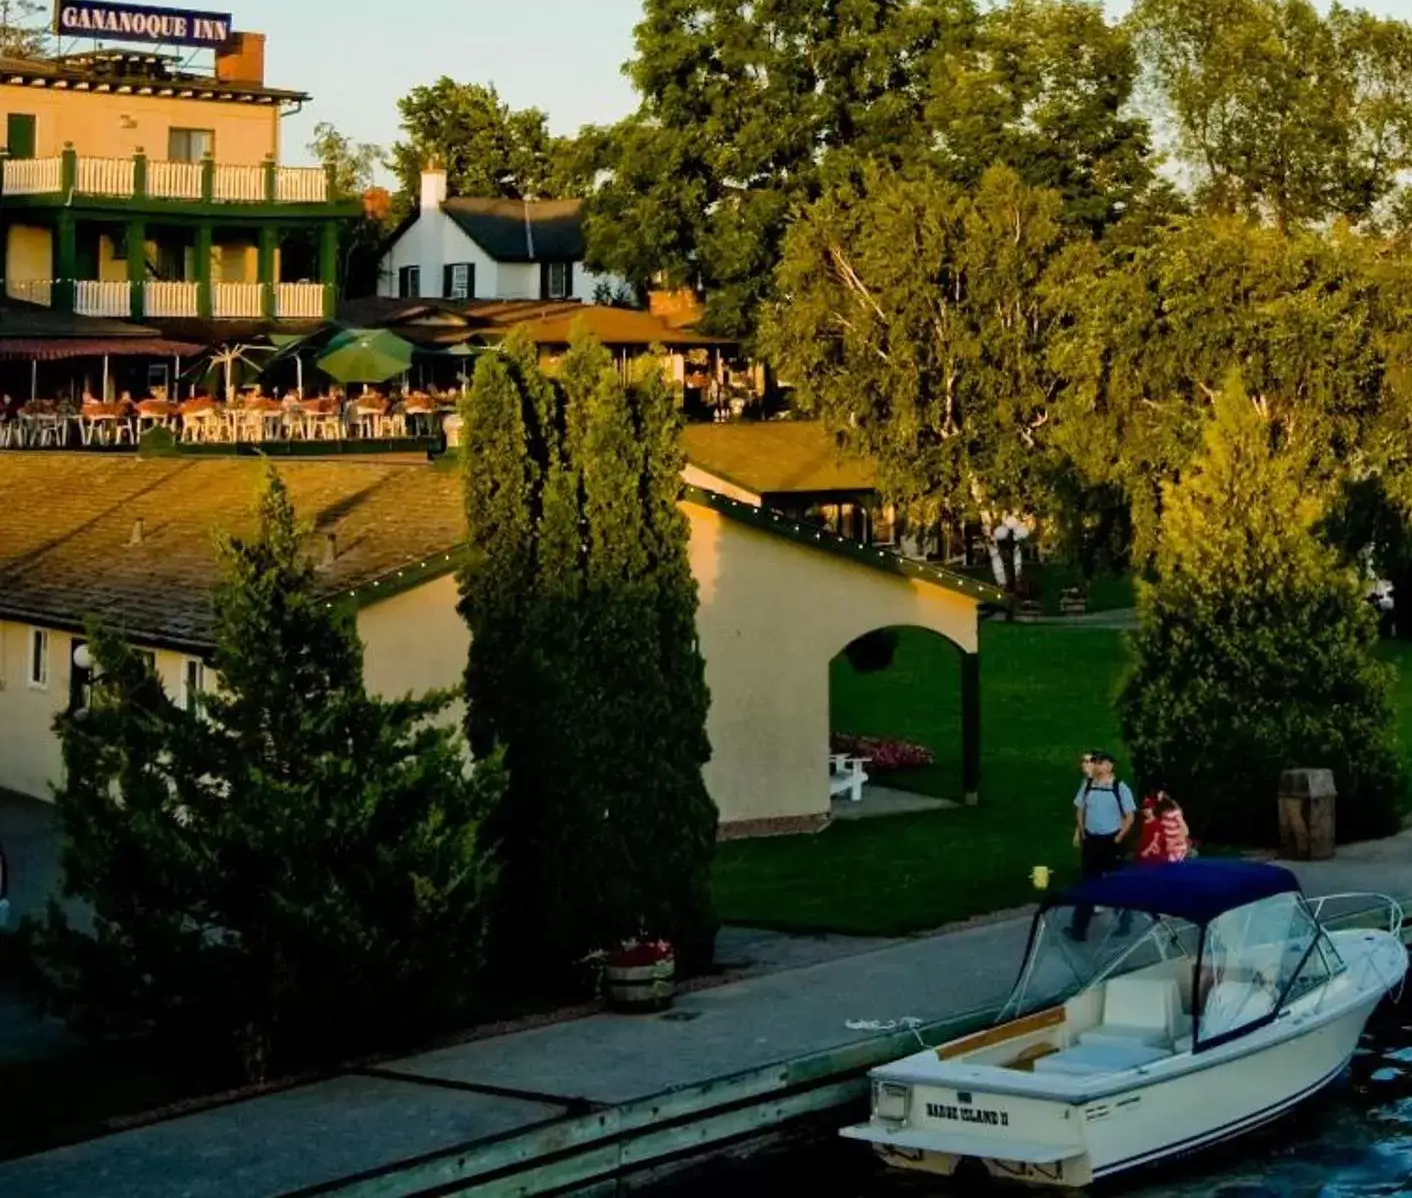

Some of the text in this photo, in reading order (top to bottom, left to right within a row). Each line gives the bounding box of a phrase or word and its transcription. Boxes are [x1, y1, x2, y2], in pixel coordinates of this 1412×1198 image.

[62, 6, 227, 41] GANANOQUE INN
[960, 1107, 999, 1126] ISLAND
